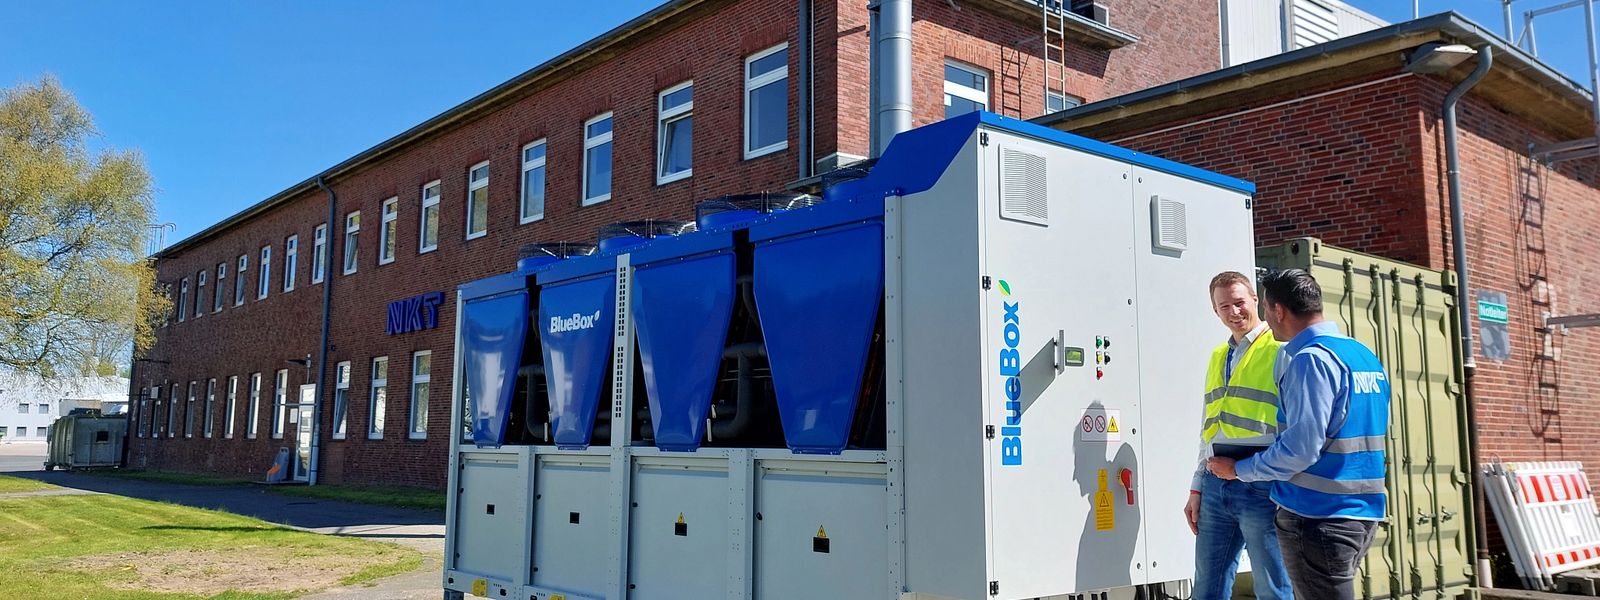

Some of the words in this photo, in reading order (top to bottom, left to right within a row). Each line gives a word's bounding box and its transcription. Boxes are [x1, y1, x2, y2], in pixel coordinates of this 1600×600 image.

[386, 291, 445, 335] NKT
[550, 313, 594, 333] BlueBox
[1000, 301, 1022, 466] BlueBox
